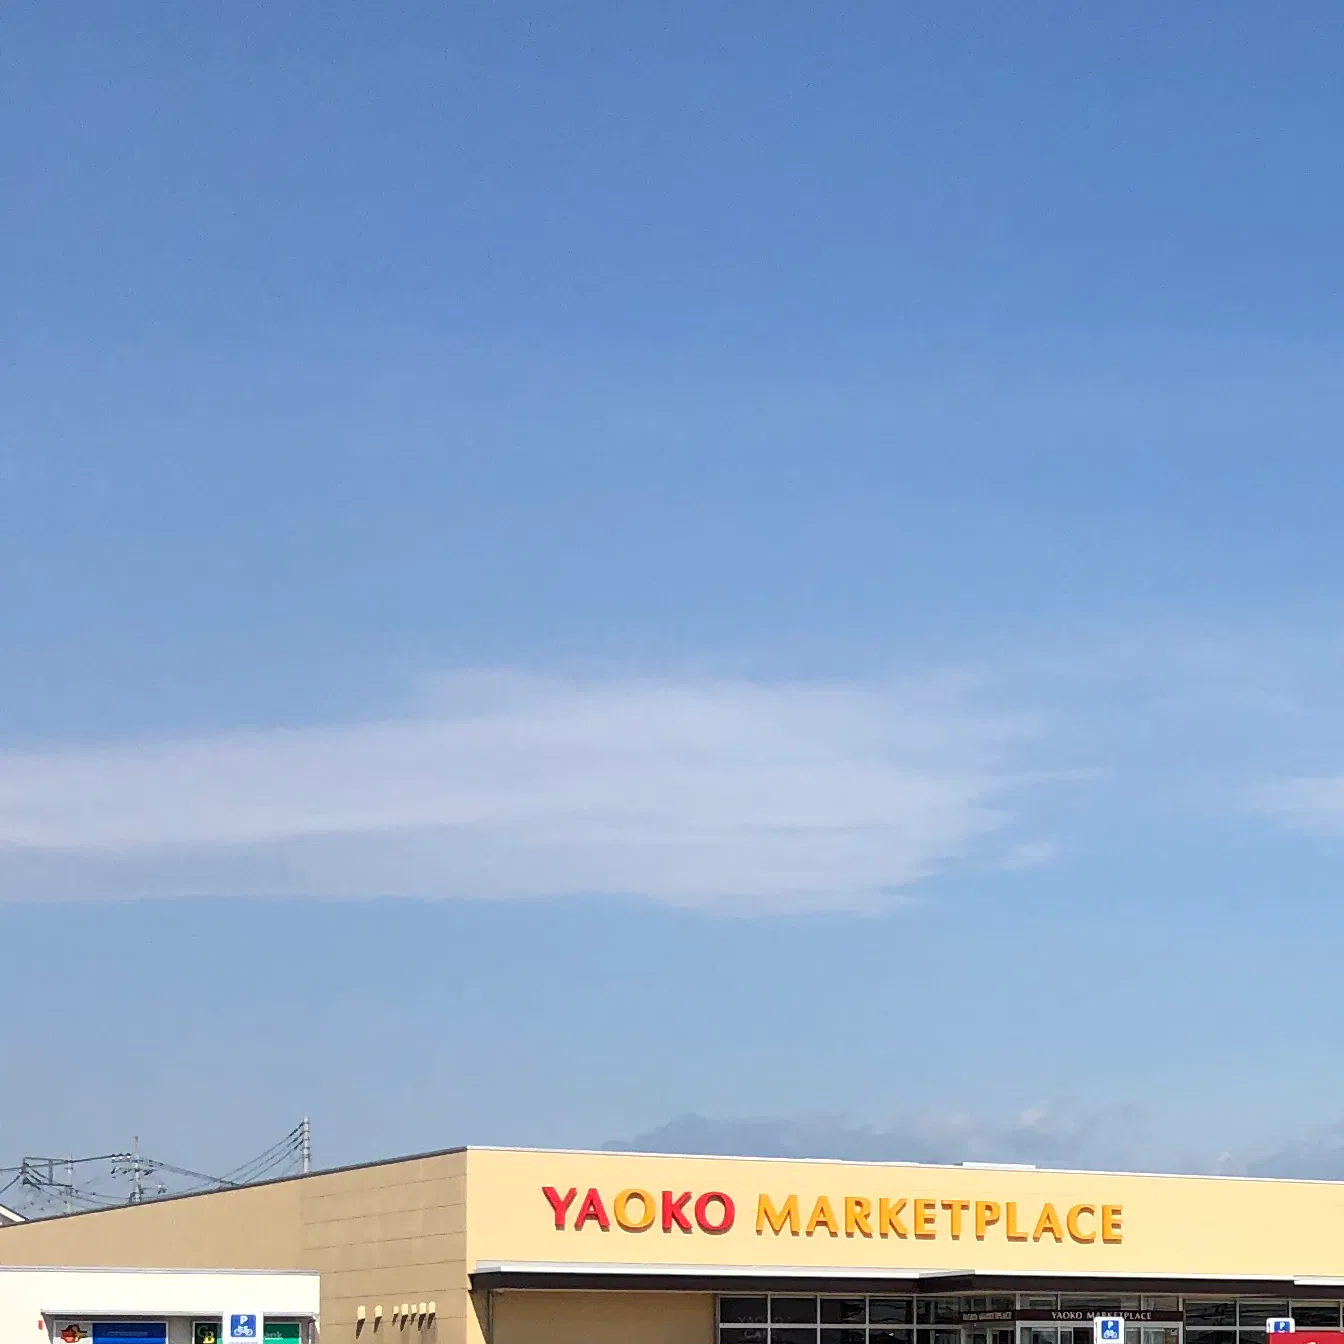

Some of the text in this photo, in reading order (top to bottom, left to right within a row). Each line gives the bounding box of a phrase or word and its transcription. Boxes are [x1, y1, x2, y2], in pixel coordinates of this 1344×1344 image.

[542, 1186, 1124, 1244] YAOKO MARKETPLACE
[1051, 1311, 1083, 1319] YAOKO
